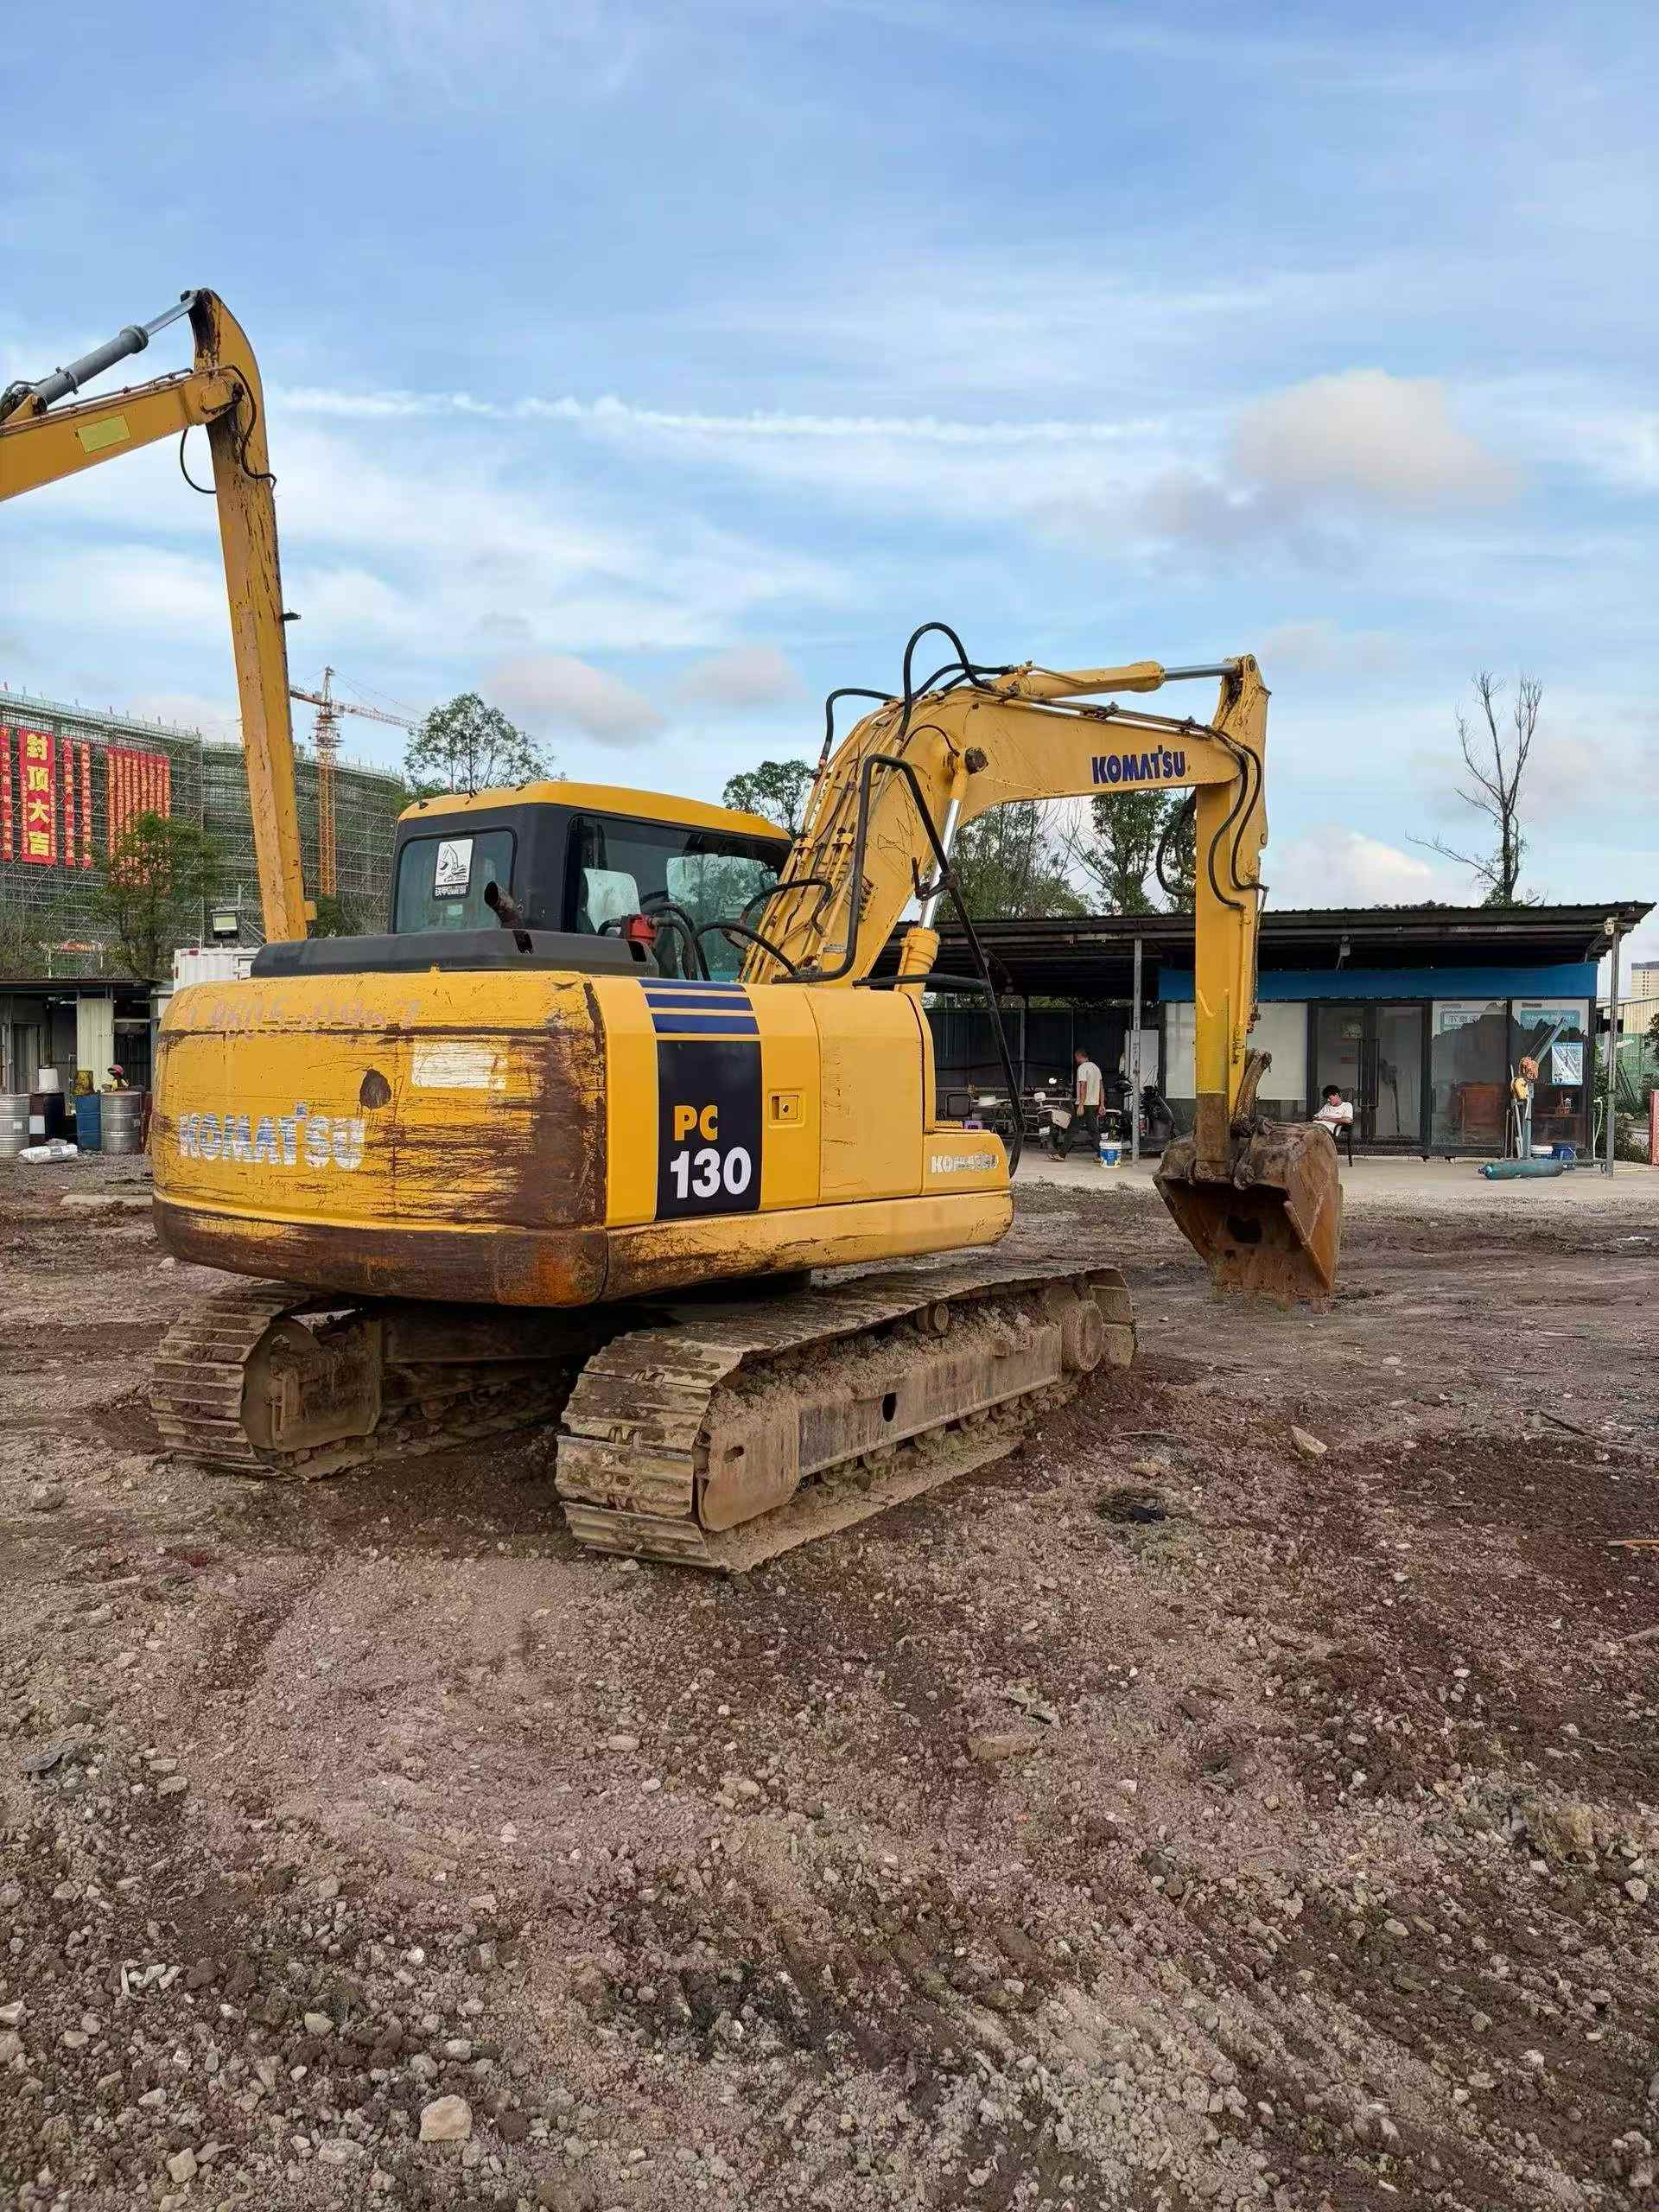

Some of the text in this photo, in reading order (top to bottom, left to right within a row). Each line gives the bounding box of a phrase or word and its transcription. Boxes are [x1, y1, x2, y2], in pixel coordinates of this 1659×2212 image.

[1091, 744, 1186, 785] KOMATSU
[179, 1101, 365, 1169] KOMATSU
[674, 1105, 719, 1141] PC
[670, 1147, 752, 1199] 130
